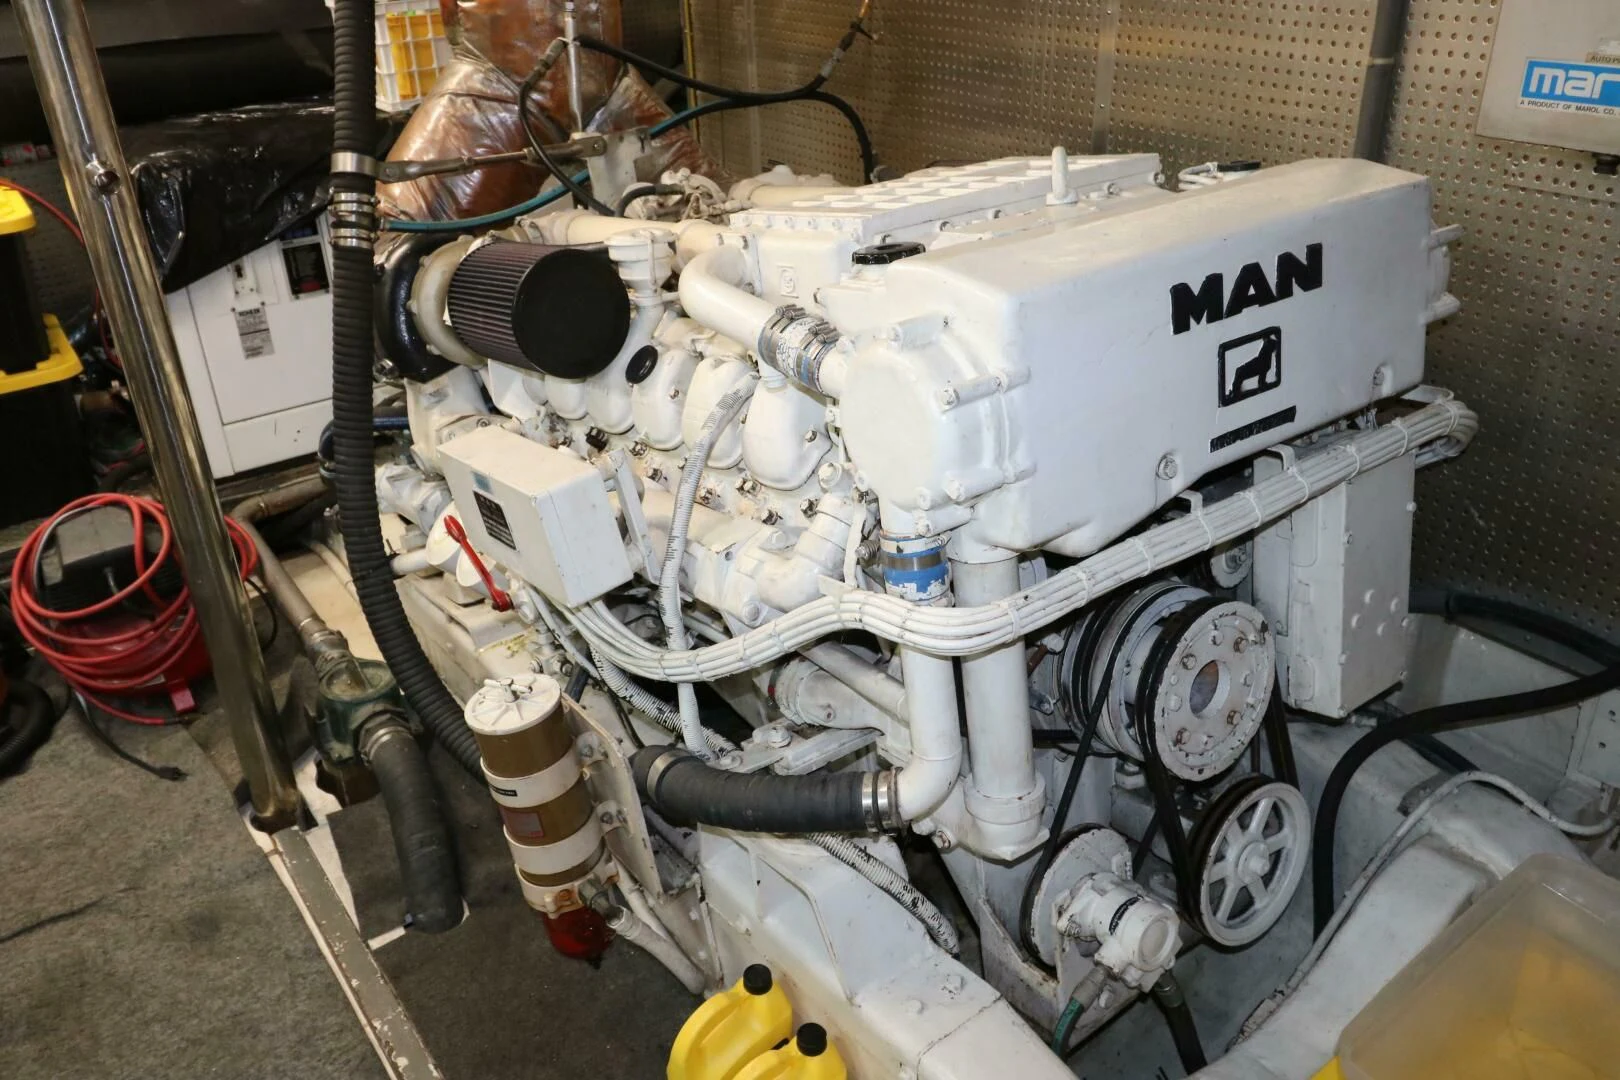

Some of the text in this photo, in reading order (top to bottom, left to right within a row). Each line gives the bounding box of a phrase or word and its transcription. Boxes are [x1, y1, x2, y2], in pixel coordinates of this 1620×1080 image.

[1528, 67, 1620, 99] mar
[1527, 100, 1559, 109] PRODUCT
[1562, 103, 1572, 111] OF
[1170, 242, 1323, 335] MAN
